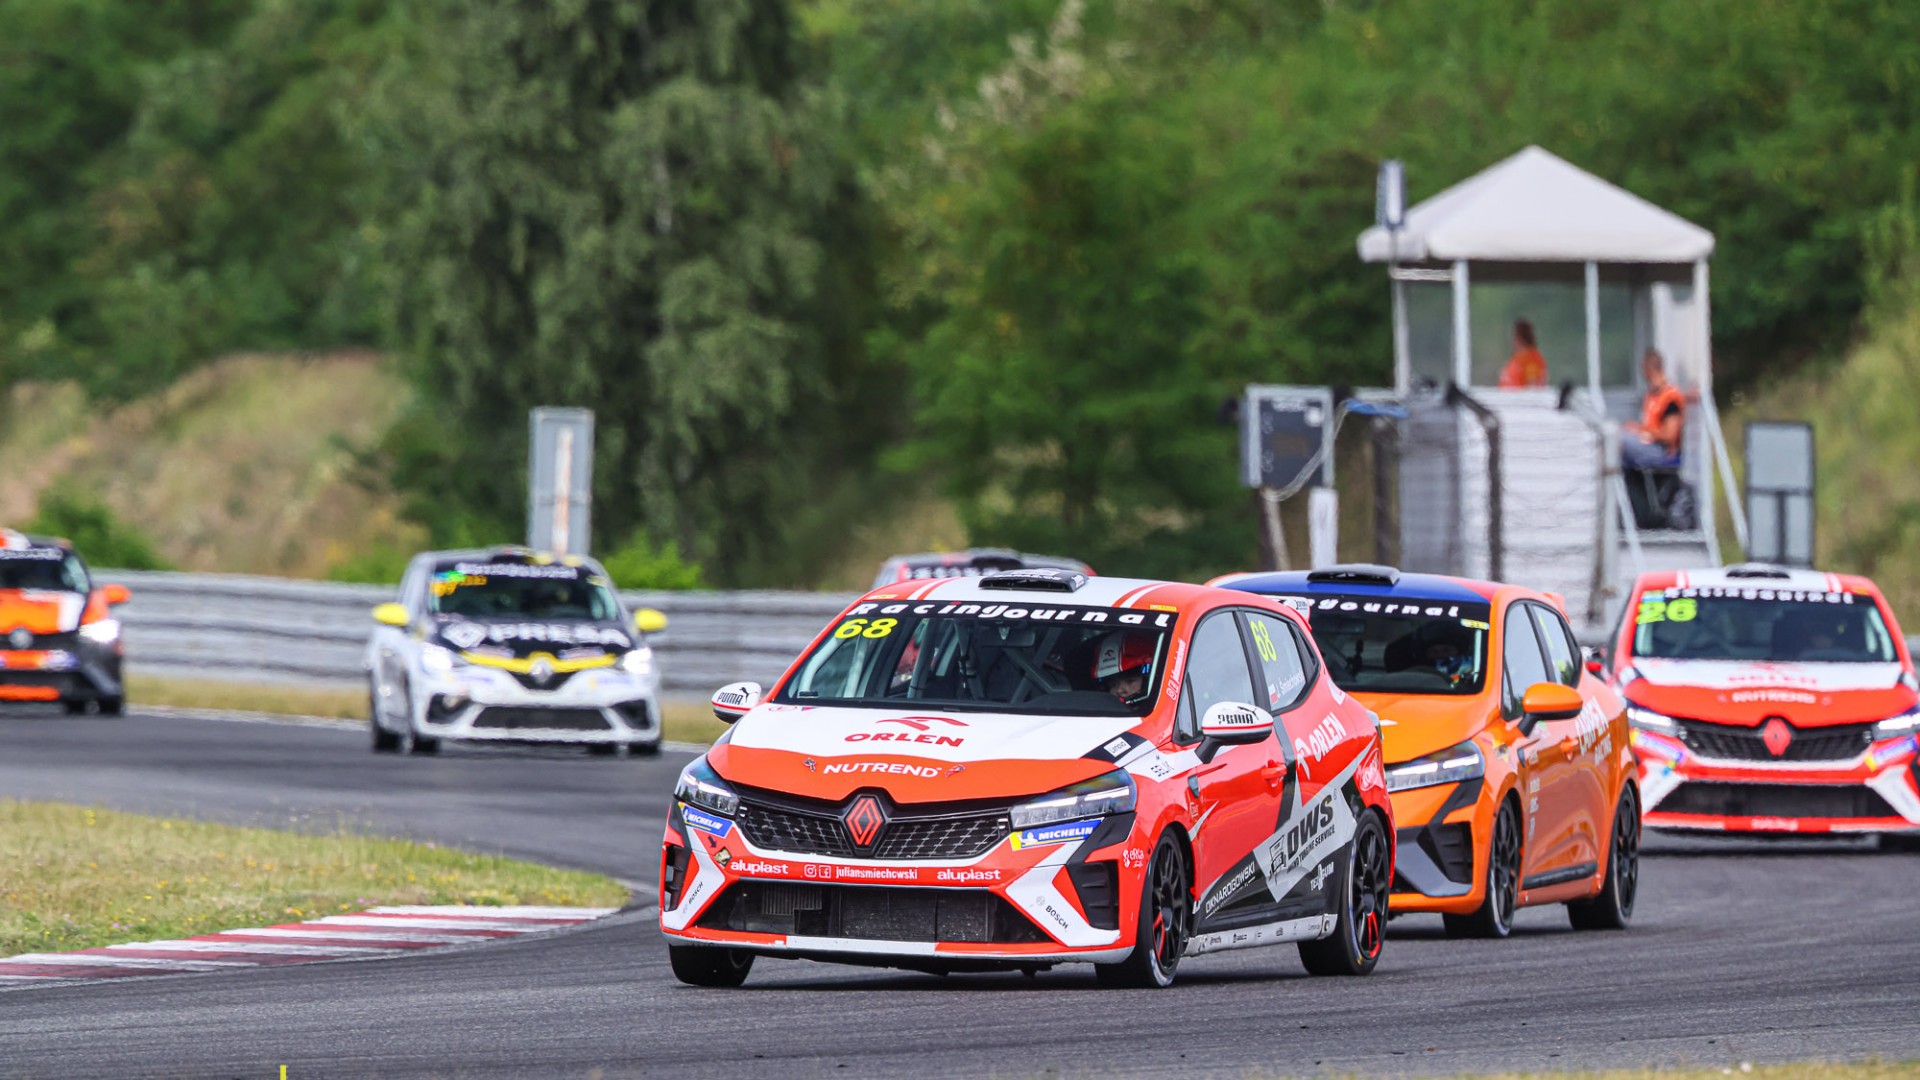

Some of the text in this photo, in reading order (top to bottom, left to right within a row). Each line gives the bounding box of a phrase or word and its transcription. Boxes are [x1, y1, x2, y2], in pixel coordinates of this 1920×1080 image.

[1636, 598, 1697, 624] 26
[834, 617, 898, 639] 68
[1250, 620, 1277, 662] 68
[716, 691, 744, 706] PUMA
[844, 732, 965, 748] ORLEN
[1308, 712, 1347, 762] ORLEN
[823, 762, 939, 778] NUTREND
[687, 813, 723, 830] MICHELIN
[1287, 794, 1334, 860] DWS
[1038, 826, 1094, 841] MICHELIN
[1314, 824, 1336, 847] SERVICE
[731, 860, 789, 875] aluplast
[937, 868, 1001, 883] aluplast
[1045, 905, 1069, 929] BOSCH
